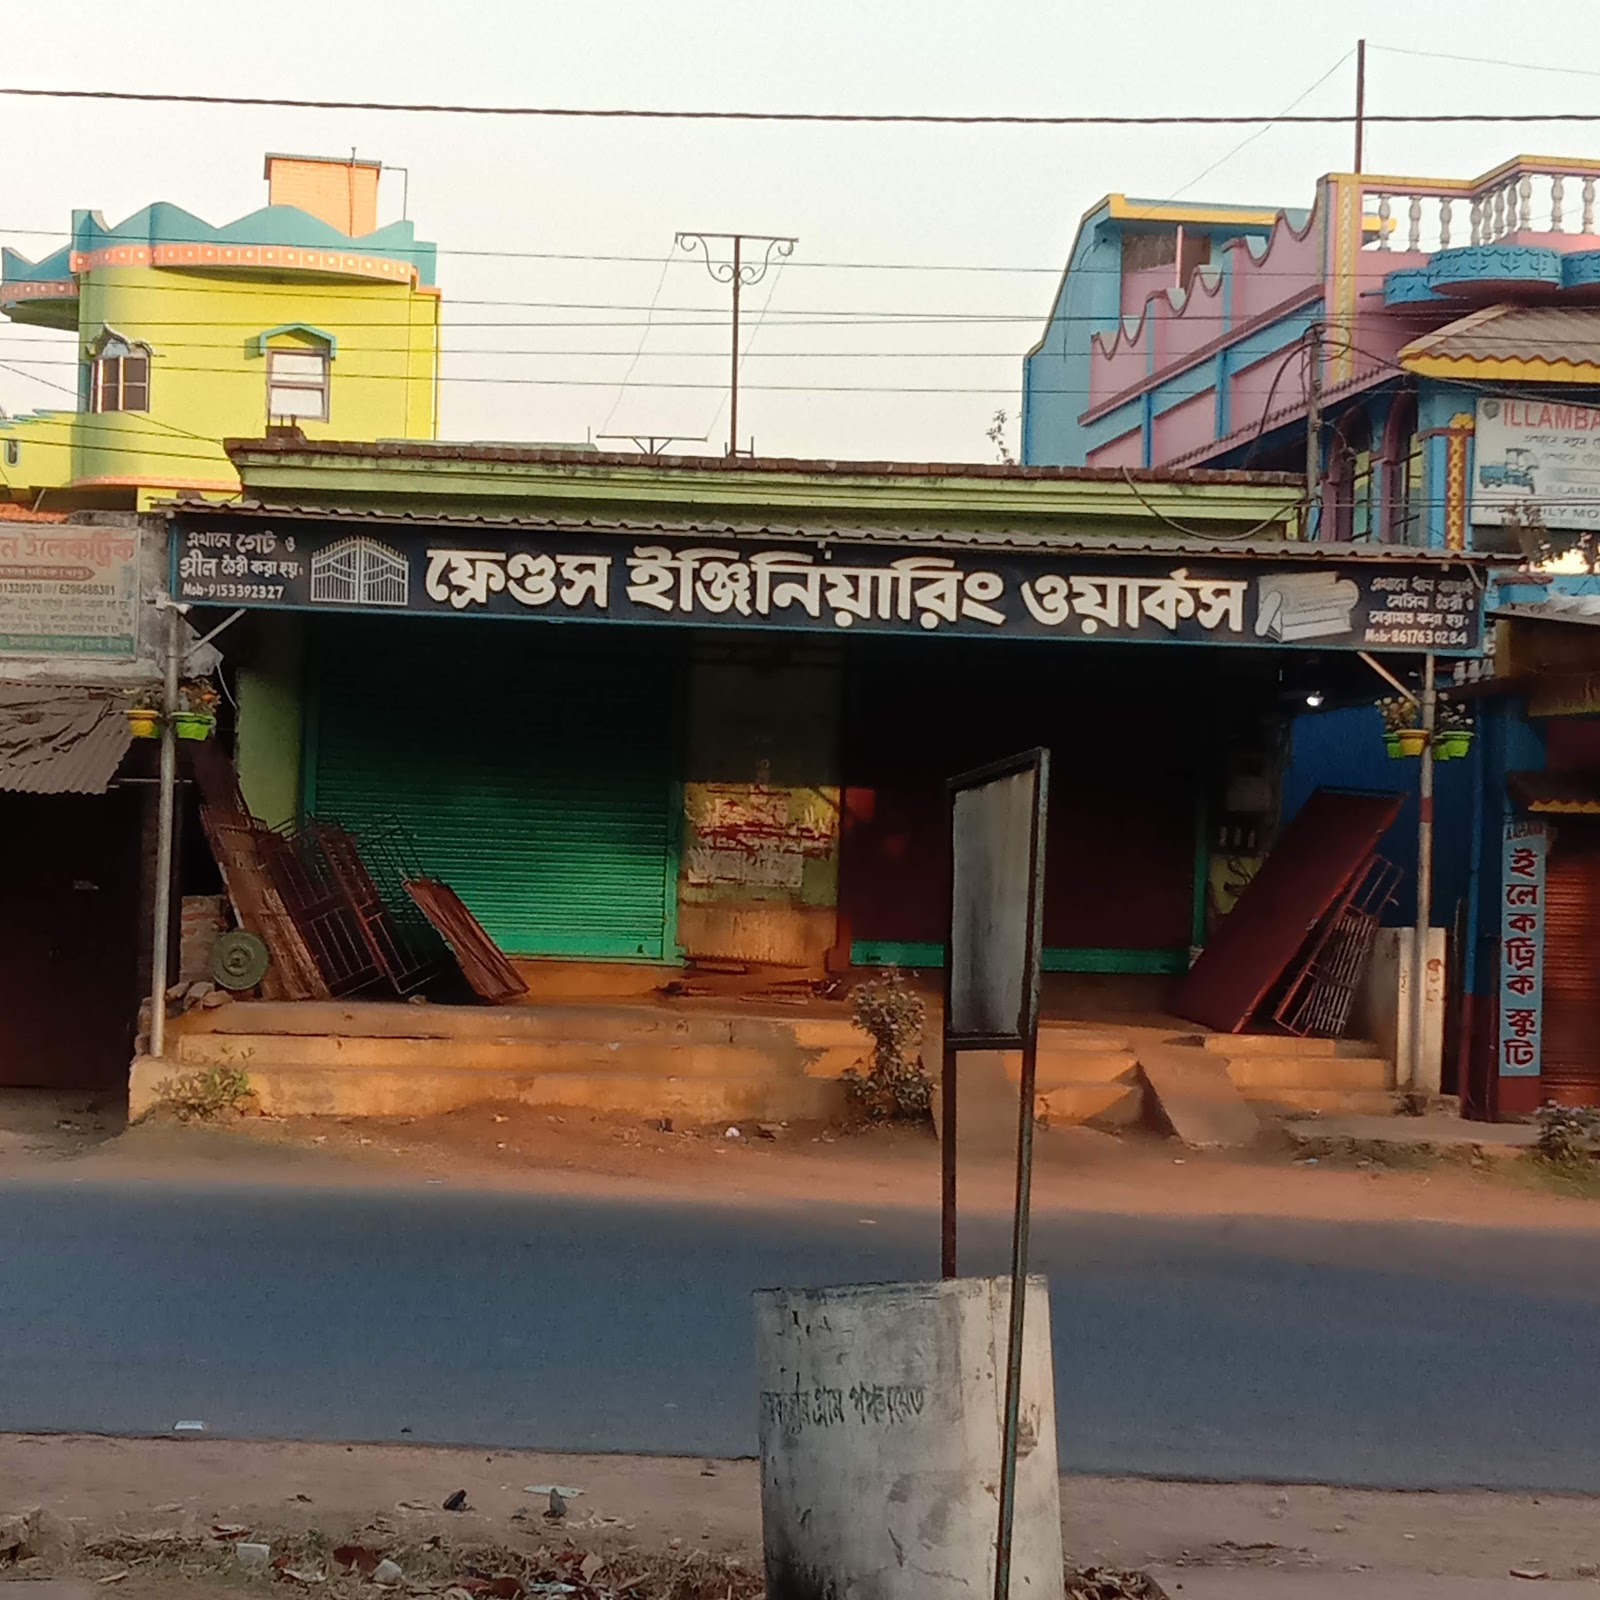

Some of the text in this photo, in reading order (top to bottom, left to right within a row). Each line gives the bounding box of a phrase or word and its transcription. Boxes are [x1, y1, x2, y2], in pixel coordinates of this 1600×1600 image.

[186, 530, 296, 554] এখানে গেট ও
[180, 549, 219, 579] গ্রীল
[250, 560, 277, 578] করা
[1020, 567, 1249, 635] ওয়ার্কস
